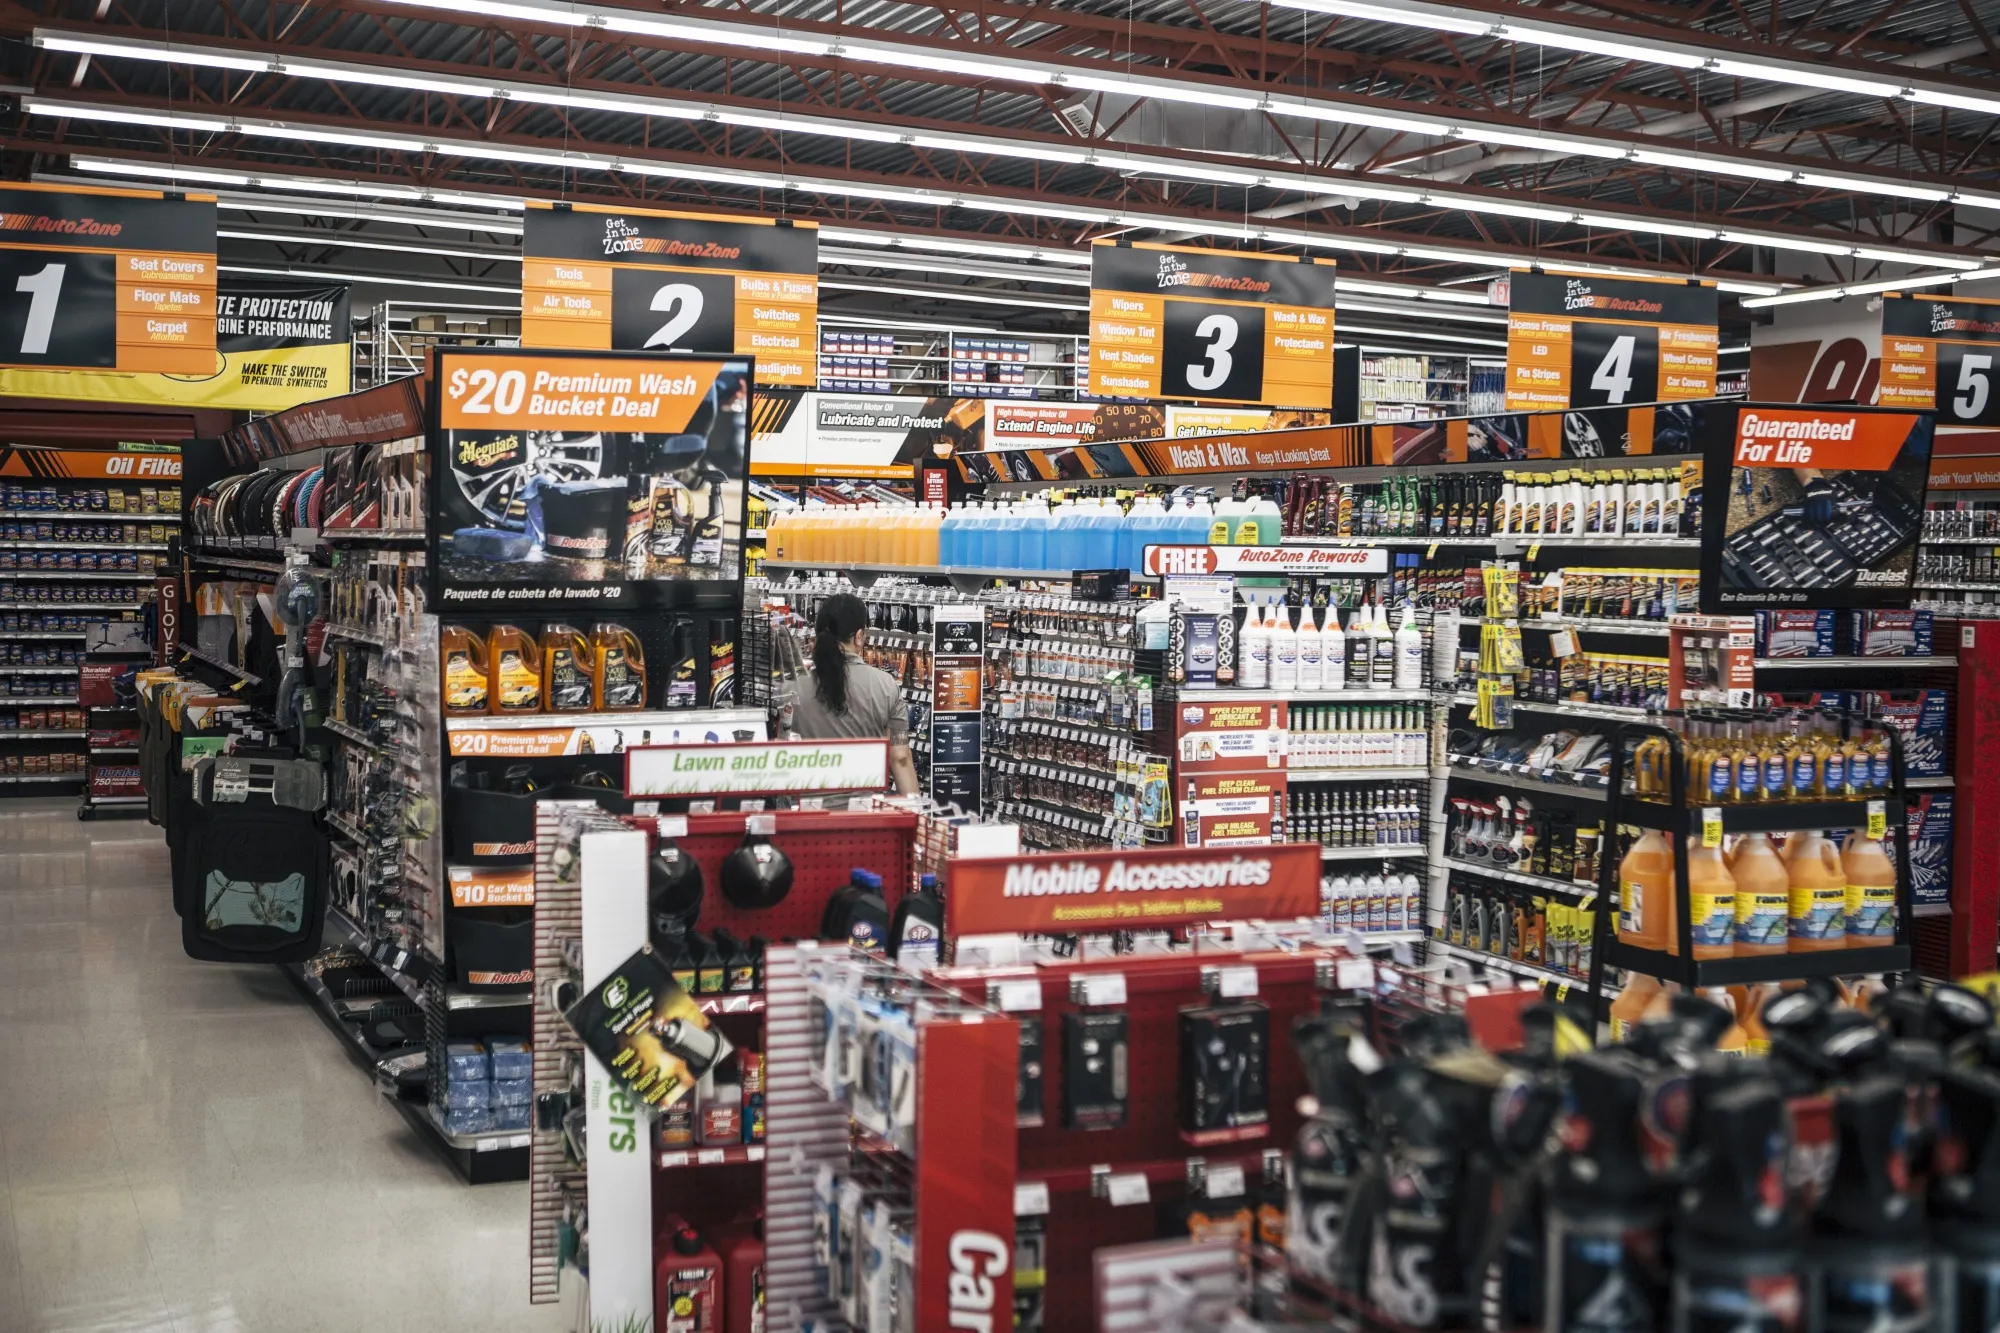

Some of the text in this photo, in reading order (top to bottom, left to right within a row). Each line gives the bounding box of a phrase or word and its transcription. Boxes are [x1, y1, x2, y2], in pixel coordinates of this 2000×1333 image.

[32, 216, 122, 236] AutoZone
[606, 218, 626, 228] Get
[606, 226, 639, 238] in the
[602, 236, 643, 255] Zone
[667, 240, 740, 259] AutoZone
[130, 258, 204, 273] Seat Covers
[555, 267, 583, 280] Tools
[741, 279, 812, 293] Bulbs & Fuses
[1209, 275, 1271, 292] AutoZone
[134, 289, 200, 305] Floor Mats
[544, 295, 591, 309] Air Tools
[15, 263, 66, 354] 1
[217, 297, 333, 321] TE PROTECTION
[1112, 298, 1144, 312] Wipers
[1610, 299, 1663, 313] AutoZone
[643, 283, 704, 354] 2
[753, 308, 800, 321] Switches
[1273, 311, 1327, 325] Wash & Wax
[147, 320, 188, 337] Carpet
[217, 319, 332, 340] GINE PERFORMANCE
[1099, 323, 1155, 338] Window Tint
[1510, 319, 1571, 333] License Frames
[752, 335, 799, 348] Electrical
[1274, 336, 1325, 350] Protectants
[1660, 330, 1717, 342] Air Fresheners
[1186, 314, 1239, 391] 3
[1532, 345, 1548, 355] LED
[1894, 341, 1924, 352] Sealants
[1099, 350, 1155, 364] Vent Shades
[1663, 352, 1713, 365] Wheel Covers
[241, 363, 327, 379] MAKE THE SWITCH
[755, 362, 802, 375] eadlights
[1516, 367, 1560, 381] Pin Stripes
[1590, 335, 1636, 404] 4
[1890, 363, 1926, 374] Adhesives
[241, 375, 328, 389] TO PENNZOIL SYNTHETICS
[1101, 375, 1149, 389] Sunshades
[1667, 376, 1707, 388] Car Covers
[1953, 353, 1993, 420] 5
[449, 367, 697, 416] $20 Premium Wash
[1507, 391, 1569, 403] Small Accessories
[1881, 386, 1936, 397] Help! Accessories
[528, 395, 659, 418] Bucket Deal
[820, 401, 894, 411] Conventional Motor Oil
[997, 407, 1067, 419] High Mileage Motor Oil
[1106, 405, 1137, 416] 50 60
[820, 411, 943, 429] Lubricate and Protect
[996, 419, 1096, 435] Extend Engine Life
[1091, 415, 1151, 425] 40 70
[1176, 415, 1232, 425] Synthetic Motor Oil
[1741, 413, 1856, 441] Guaranteed
[1150, 427, 1163, 437] 80
[1176, 425, 1195, 438] Get
[1168, 442, 1331, 469] Wash & Wax Keep It Looking Great
[1736, 438, 1812, 464] For Life
[105, 456, 182, 476] Oil Filte
[1952, 471, 1971, 485] Your
[1973, 470, 2000, 485] Vehicl
[1159, 548, 1369, 574] FREE AutoZone Rewards
[1855, 568, 1908, 582] Duralast
[443, 586, 621, 600] Paquete de cubeta de lavado $20
[1720, 593, 1735, 602] Con
[1768, 593, 1777, 602] De
[1778, 593, 1791, 603] Por
[1791, 593, 1808, 602] Vida
[1215, 713, 1250, 721] LUBRICANT
[1230, 706, 1261, 715] CYLINDER
[1880, 704, 1921, 716] Duralast
[1210, 719, 1263, 728] FUEL TREATMENT
[453, 734, 565, 753] $20 Premium Wash
[490, 745, 549, 754] Bucket Deal
[673, 749, 843, 772] Lawn and Garden
[1219, 780, 1235, 788] DEEP
[1202, 787, 1217, 796] FUEL
[1218, 787, 1242, 795] SYSTEM
[1211, 828, 1260, 837] FUEL TREATMENT
[1214, 823, 1230, 831] HIGH
[1003, 856, 1272, 898] Mobile Accessories
[455, 884, 534, 904] $10 Car Wash
[487, 893, 524, 902] Bucket
[911, 928, 929, 939] STP
[611, 994, 655, 1035] Spark Plugs
[682, 1269, 705, 1280] GALLON
[948, 1230, 1009, 1333] Car
